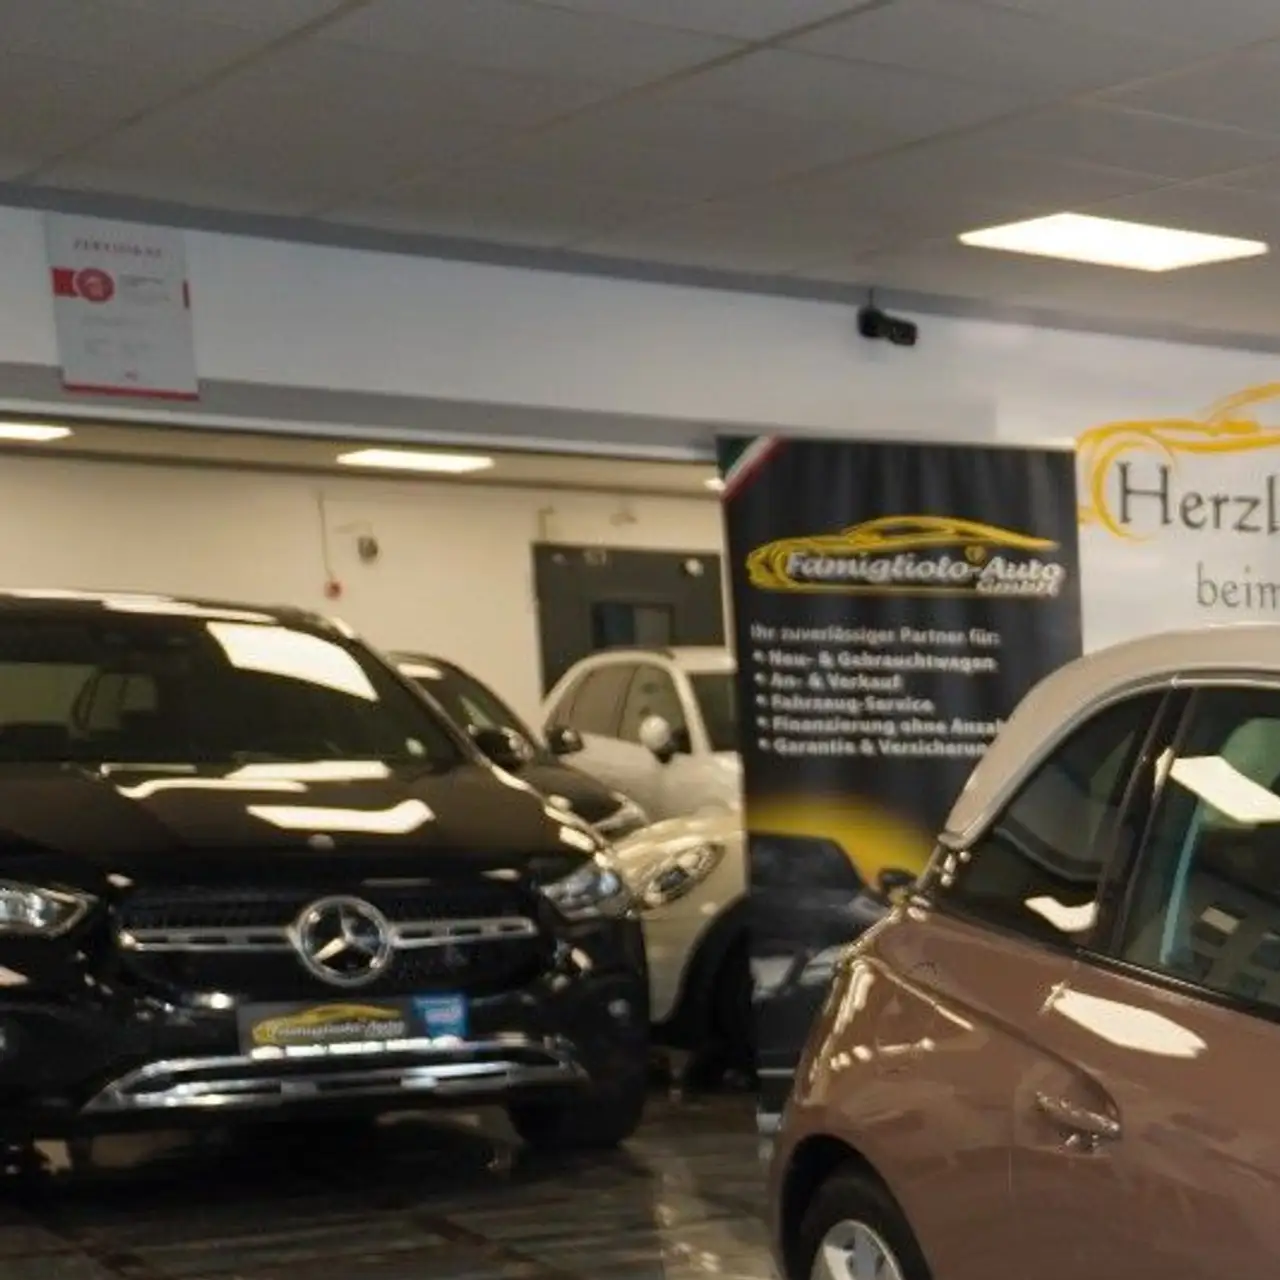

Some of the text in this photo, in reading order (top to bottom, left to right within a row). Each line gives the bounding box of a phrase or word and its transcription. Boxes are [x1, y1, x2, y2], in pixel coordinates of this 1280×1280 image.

[900, 626, 966, 645] Partner
[837, 651, 998, 674] Gebrauchtwagen
[828, 673, 904, 691] Verkauf
